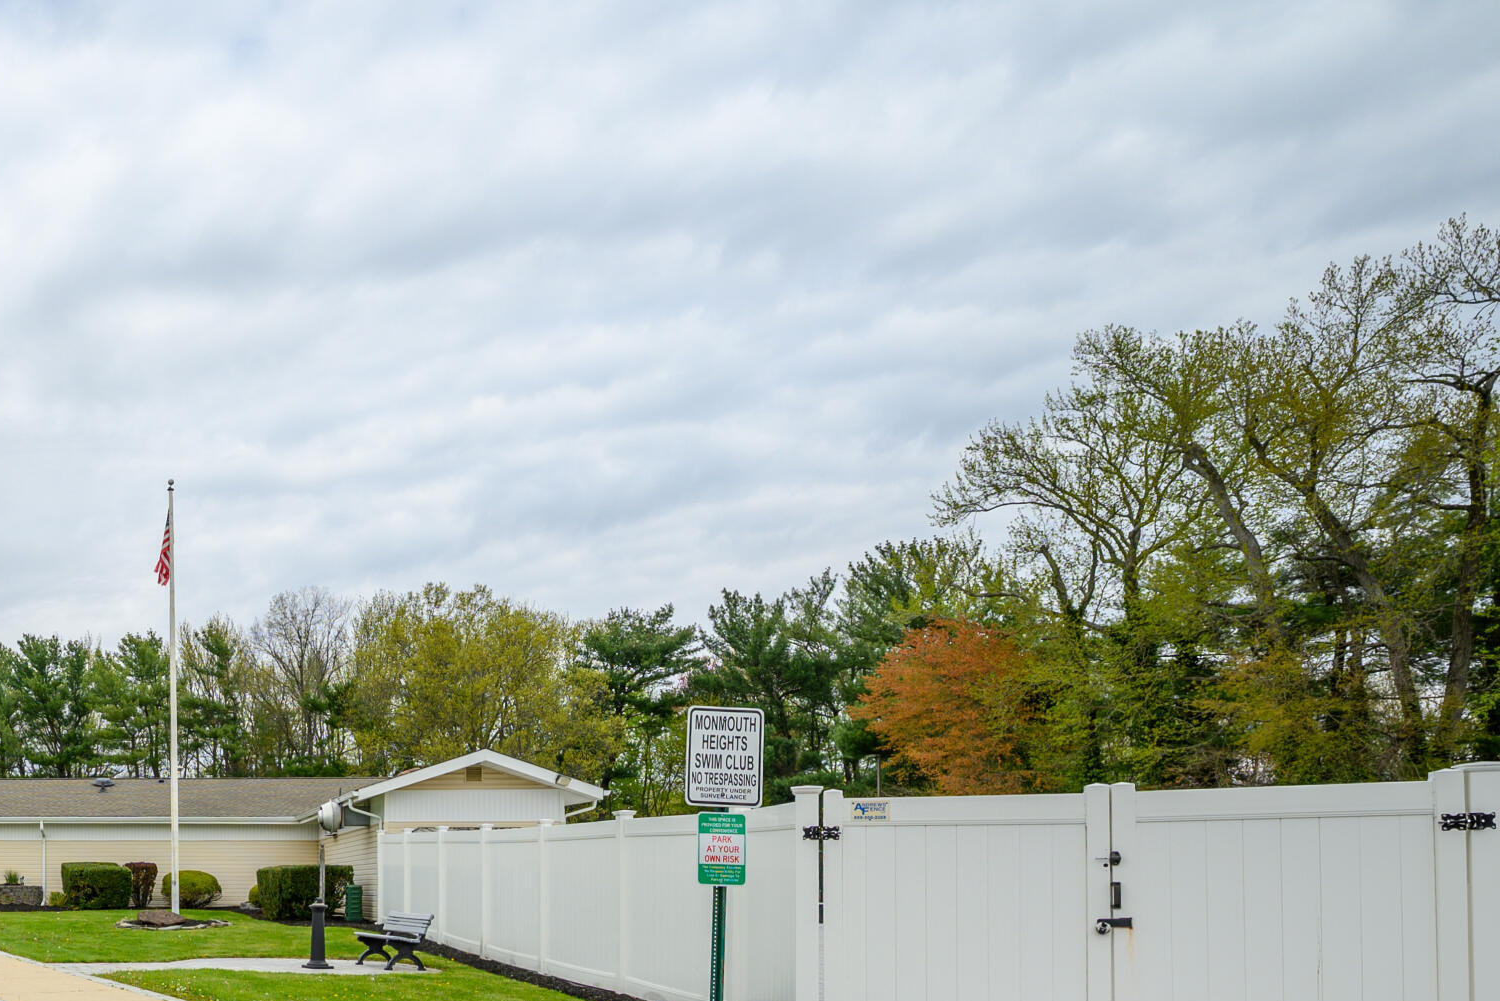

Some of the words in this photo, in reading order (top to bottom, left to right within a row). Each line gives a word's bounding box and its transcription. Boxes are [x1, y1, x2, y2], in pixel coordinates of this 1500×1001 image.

[695, 714, 757, 733] MONMOUTH
[701, 734, 748, 751] HEIGHTS
[694, 753, 723, 769] SWIM
[725, 754, 754, 771] CLUB
[691, 771, 703, 785] NO
[704, 772, 757, 787] TRESPASSING
[695, 786, 728, 794] PROPERTY
[729, 787, 752, 795] UNDER
[711, 835, 732, 843] PARK
[706, 845, 717, 853] AT
[718, 845, 740, 854] YOUR
[704, 854, 721, 863] OWN
[722, 855, 740, 864] RISK
